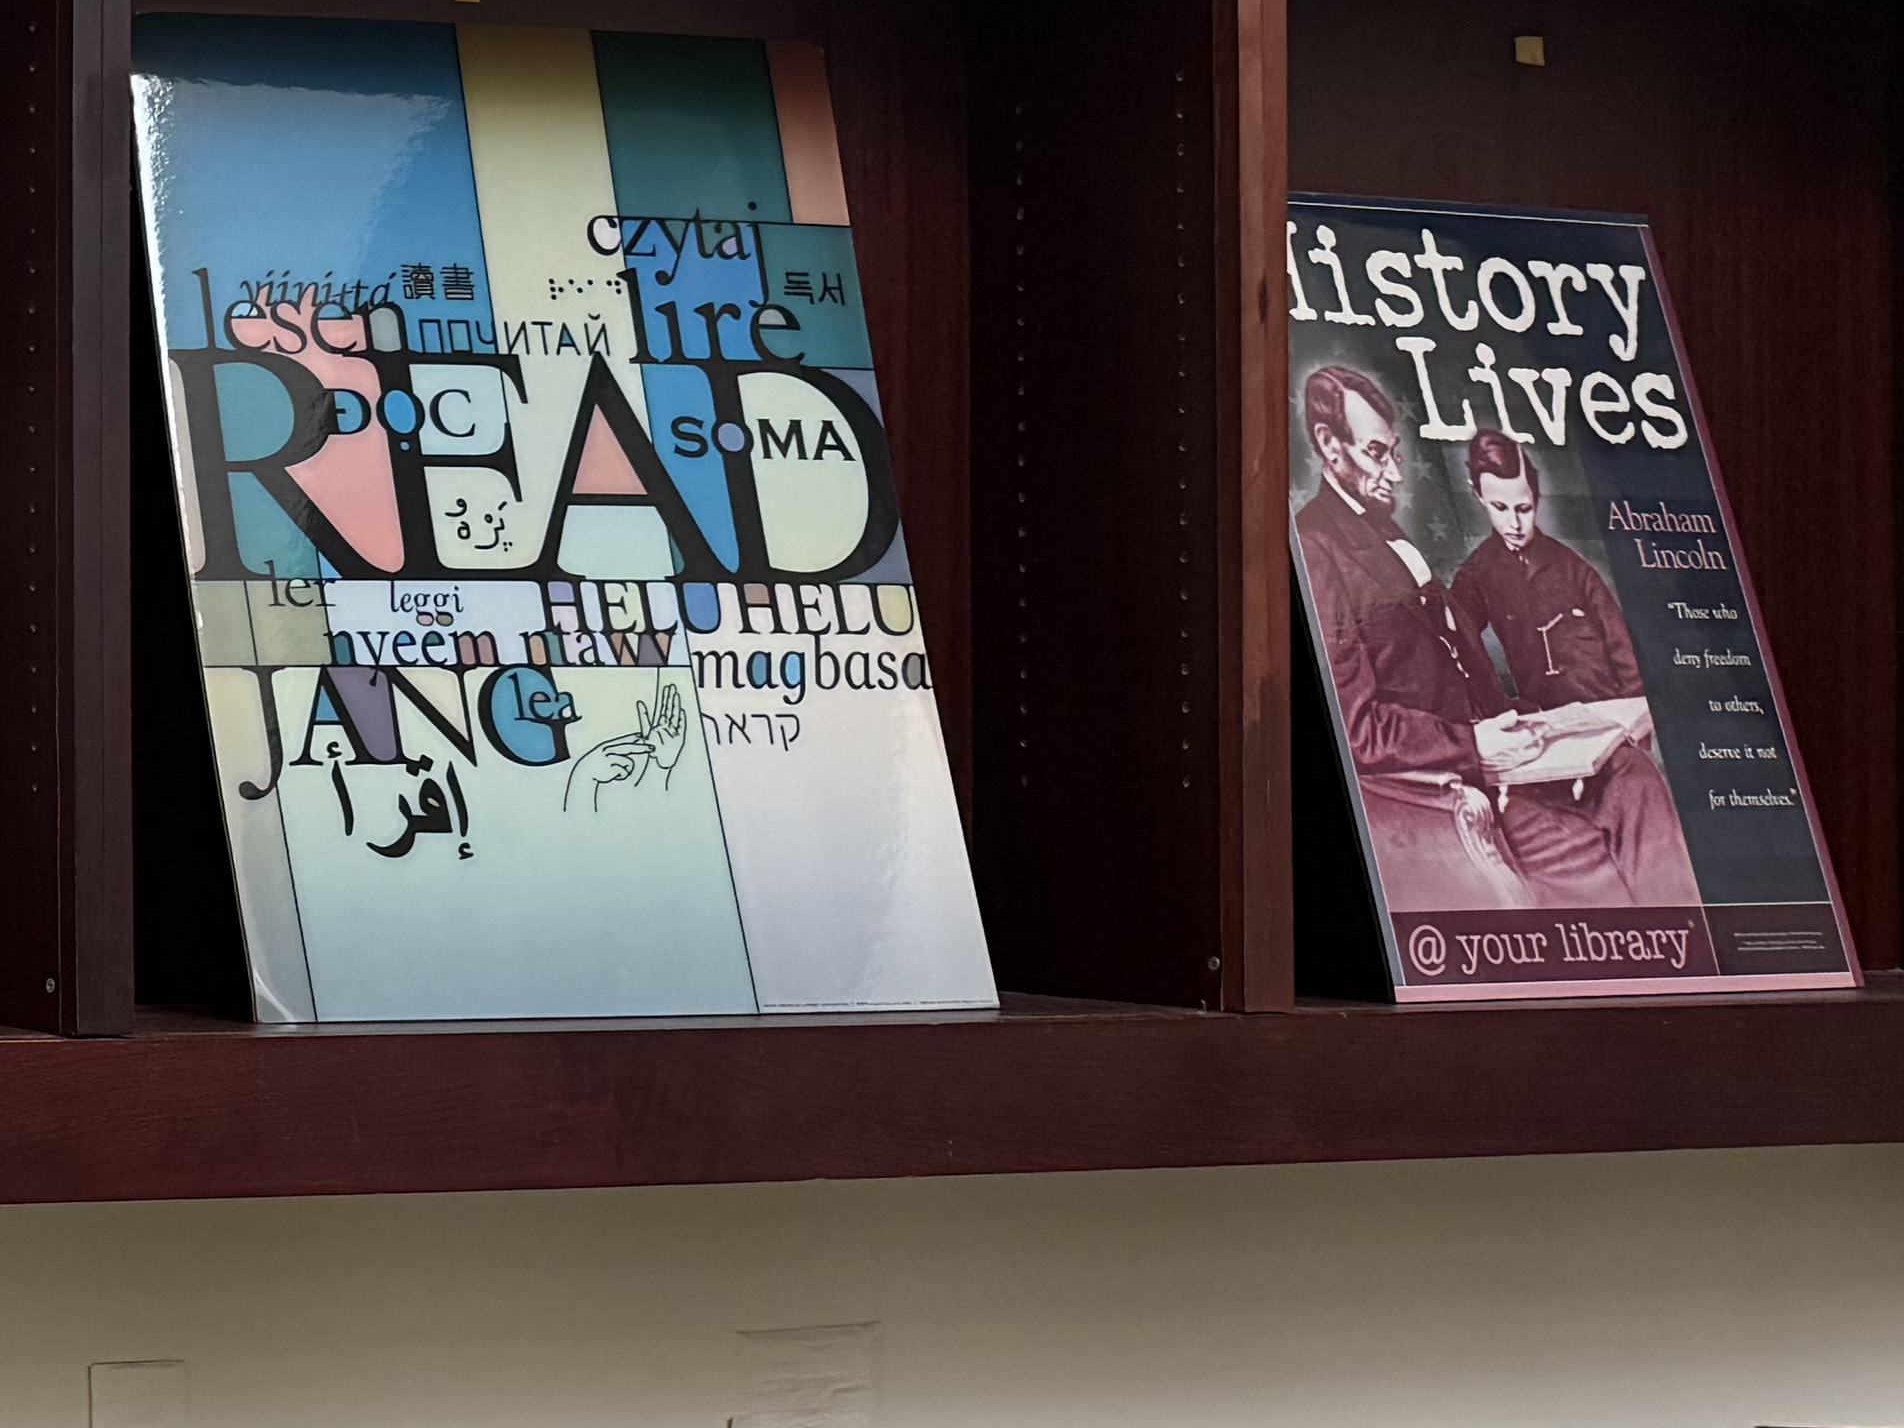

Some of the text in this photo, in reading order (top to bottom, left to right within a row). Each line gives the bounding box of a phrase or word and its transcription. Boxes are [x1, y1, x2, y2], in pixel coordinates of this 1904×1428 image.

[587, 201, 769, 307] czytaj
[400, 262, 476, 301] 讀書
[783, 271, 845, 305] 독서
[192, 268, 414, 356] lesen
[616, 267, 804, 364] lire
[1396, 337, 1688, 450] Lives
[674, 416, 856, 461] SOMA
[168, 347, 902, 582] READ
[1609, 502, 1717, 533] Abraham
[1634, 539, 1727, 570] Lincoln
[265, 560, 337, 607] ler
[390, 581, 464, 627] leggi
[1713, 604, 1738, 619] who
[692, 634, 934, 705] magbasa
[1674, 649, 1752, 668] deny freedom
[507, 672, 582, 723] lea
[1709, 699, 1721, 712] to
[238, 665, 571, 800] JANG
[1699, 742, 1777, 760] deserve it not
[1709, 789, 1726, 809] for
[1408, 923, 1448, 977] @
[1456, 927, 1548, 983] your
[1554, 921, 1692, 970] library
